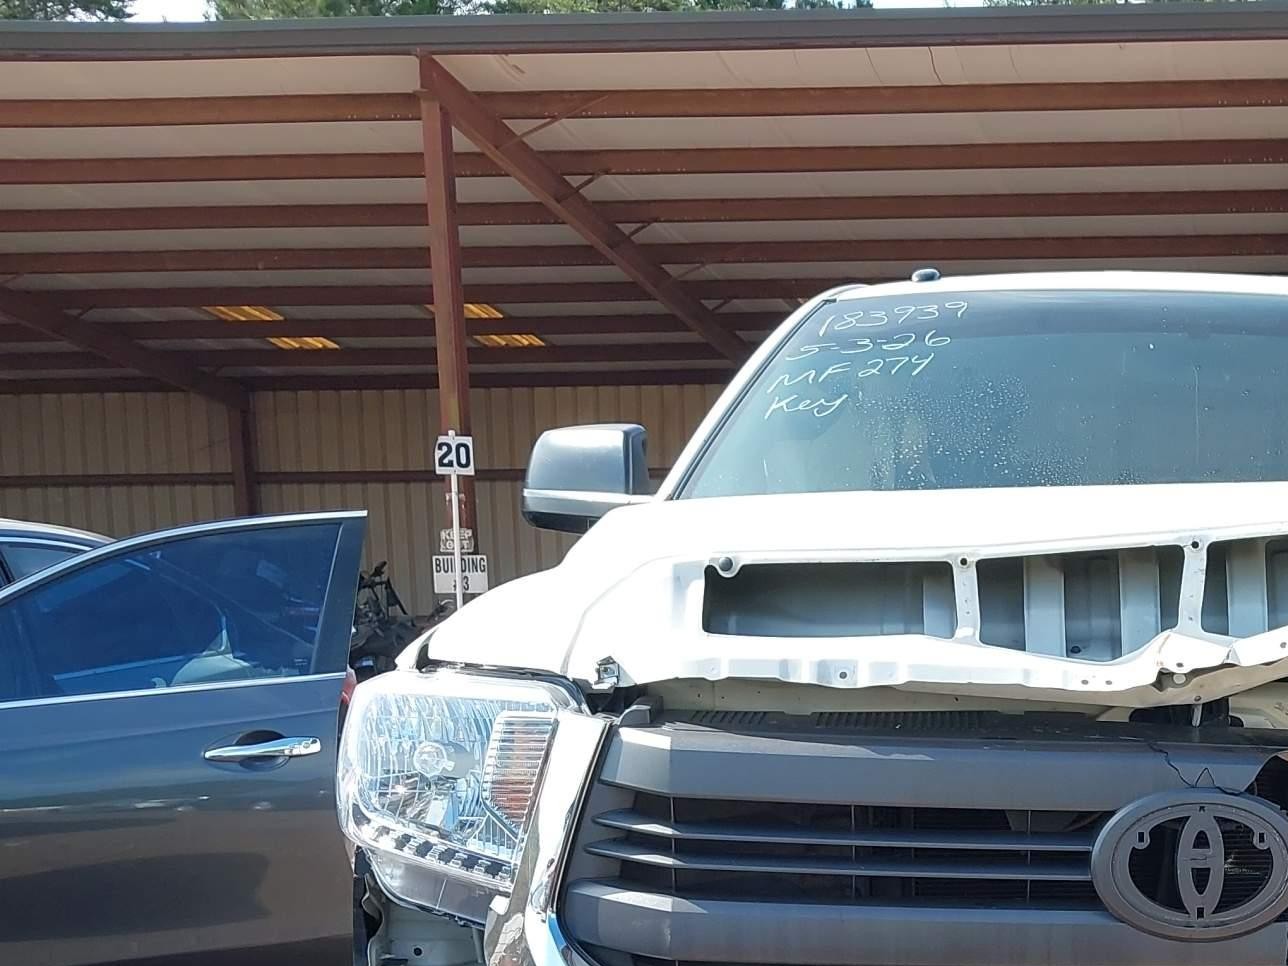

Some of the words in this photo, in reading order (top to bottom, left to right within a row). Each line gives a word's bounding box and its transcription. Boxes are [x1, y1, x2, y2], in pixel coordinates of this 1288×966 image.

[819, 301, 969, 337] 183939
[766, 362, 851, 394] MF
[764, 394, 848, 420] Key
[437, 442, 471, 468] 20
[446, 540, 470, 549] OT
[434, 557, 486, 573] BUIDING
